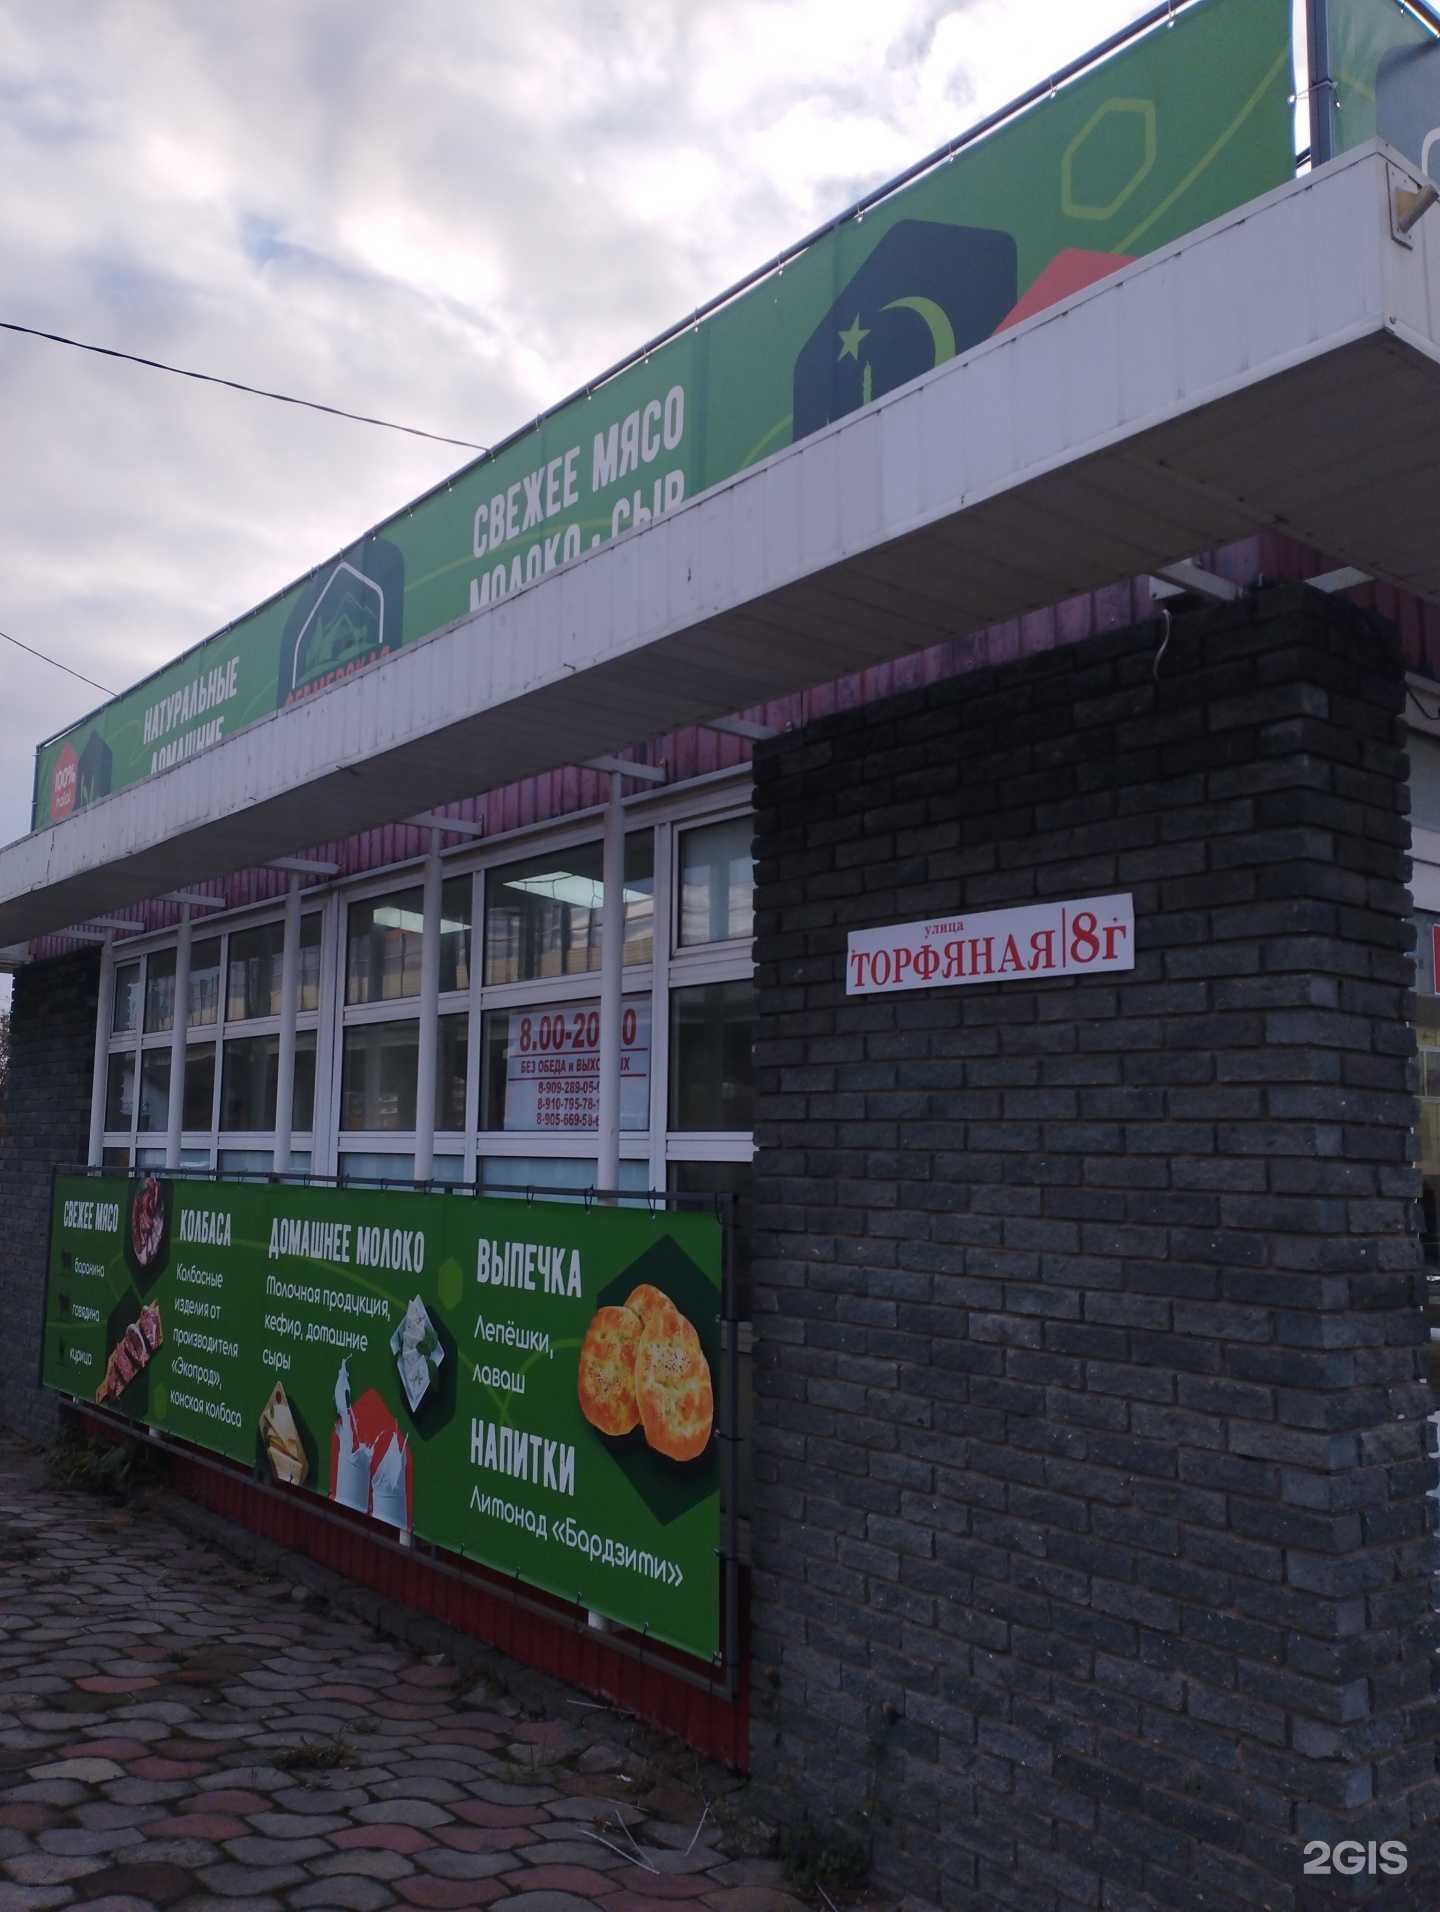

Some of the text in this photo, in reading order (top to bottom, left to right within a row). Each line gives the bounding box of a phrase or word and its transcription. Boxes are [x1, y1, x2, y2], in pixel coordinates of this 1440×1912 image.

[473, 385, 684, 558] СВЕЖЕЕ МЯСО
[143, 656, 240, 745] НАТУРАЛЬНЫЕ
[924, 920, 964, 939] улица
[850, 930, 1056, 987] ТОРФЯНАЯ
[520, 1060, 536, 1074] БЕЗ
[538, 1058, 566, 1075] ОБЕДА
[63, 1200, 119, 1233] СВЕЖЕЕ МЯСО
[180, 1209, 232, 1247] КОЛБАСА
[268, 1217, 425, 1273] ДОМАШНЕЕ МОЛОКО
[176, 1263, 224, 1288] Колбасные
[477, 1237, 582, 1298] ВЫПЕЧКА
[174, 1296, 221, 1321] изделия от
[266, 1275, 391, 1322] Молочная продукция,
[172, 1328, 239, 1358] производителя
[264, 1312, 369, 1352] кефир, домашние
[474, 1314, 554, 1359] Лепёшки,
[262, 1349, 291, 1371] сыры
[472, 1362, 526, 1395] лаваш
[169, 1389, 242, 1428] конская колбаса
[470, 1417, 576, 1497] НАПИТКИ
[470, 1485, 684, 1588] Лимонад «Бардзими»
